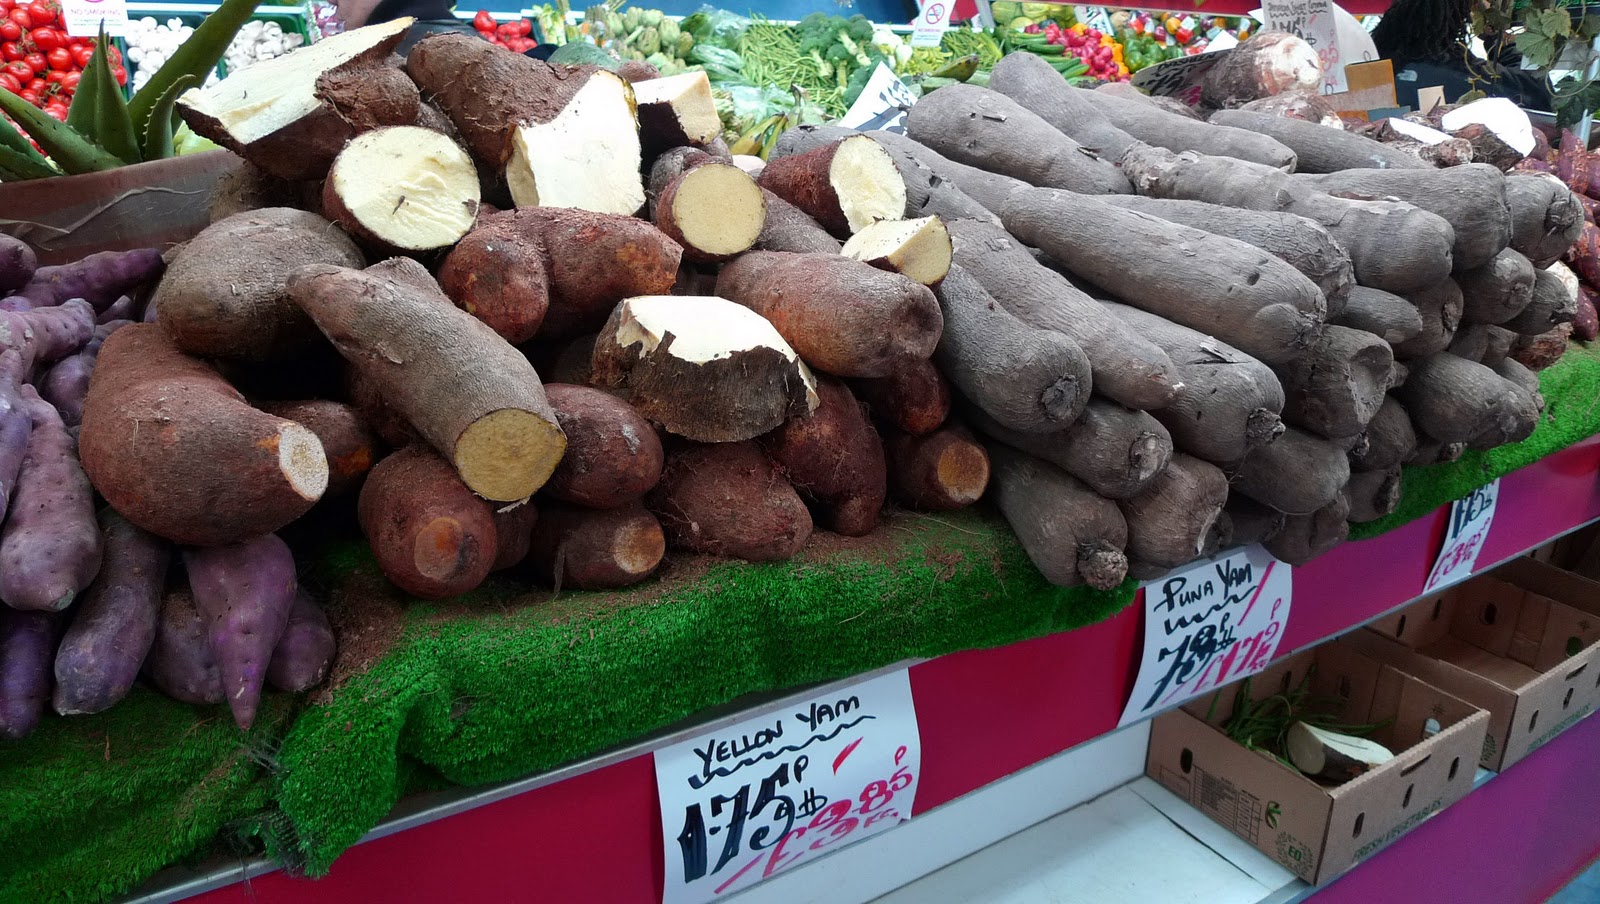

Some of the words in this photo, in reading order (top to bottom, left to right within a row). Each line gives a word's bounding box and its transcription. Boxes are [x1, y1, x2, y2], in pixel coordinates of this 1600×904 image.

[1153, 576, 1214, 612] PUNA
[1215, 559, 1252, 600] YAM
[795, 695, 860, 732] YAM
